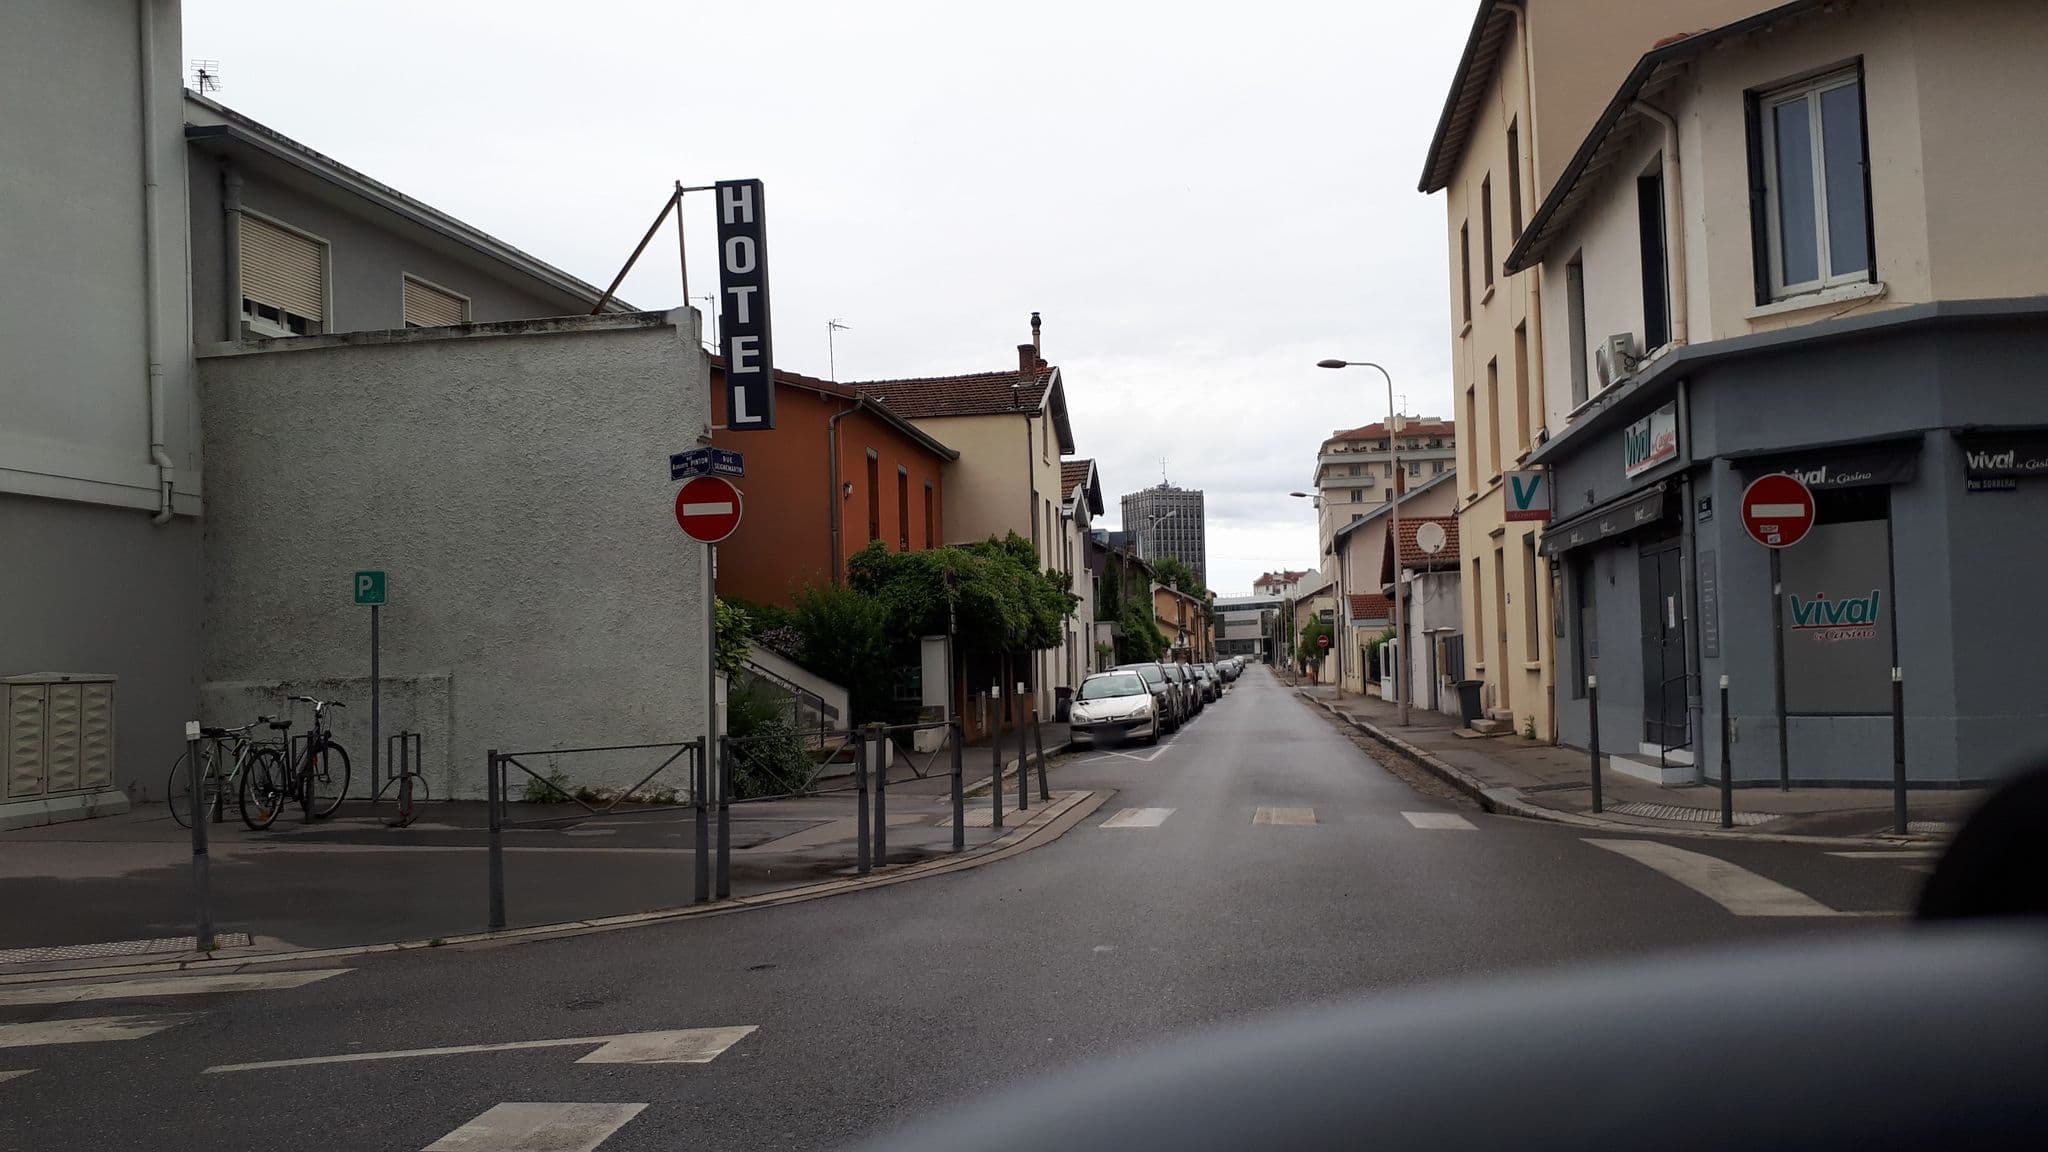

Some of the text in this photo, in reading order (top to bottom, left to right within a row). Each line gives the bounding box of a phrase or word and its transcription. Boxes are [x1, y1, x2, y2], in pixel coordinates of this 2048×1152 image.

[722, 185, 761, 424] HOTEL
[1626, 418, 1651, 467] Vival
[723, 456, 733, 464] RUE
[1511, 475, 1541, 509] V
[1836, 472, 1871, 484] Casino
[359, 575, 374, 597] P
[1789, 590, 1880, 625] Vival
[1825, 630, 1877, 640] Casino
